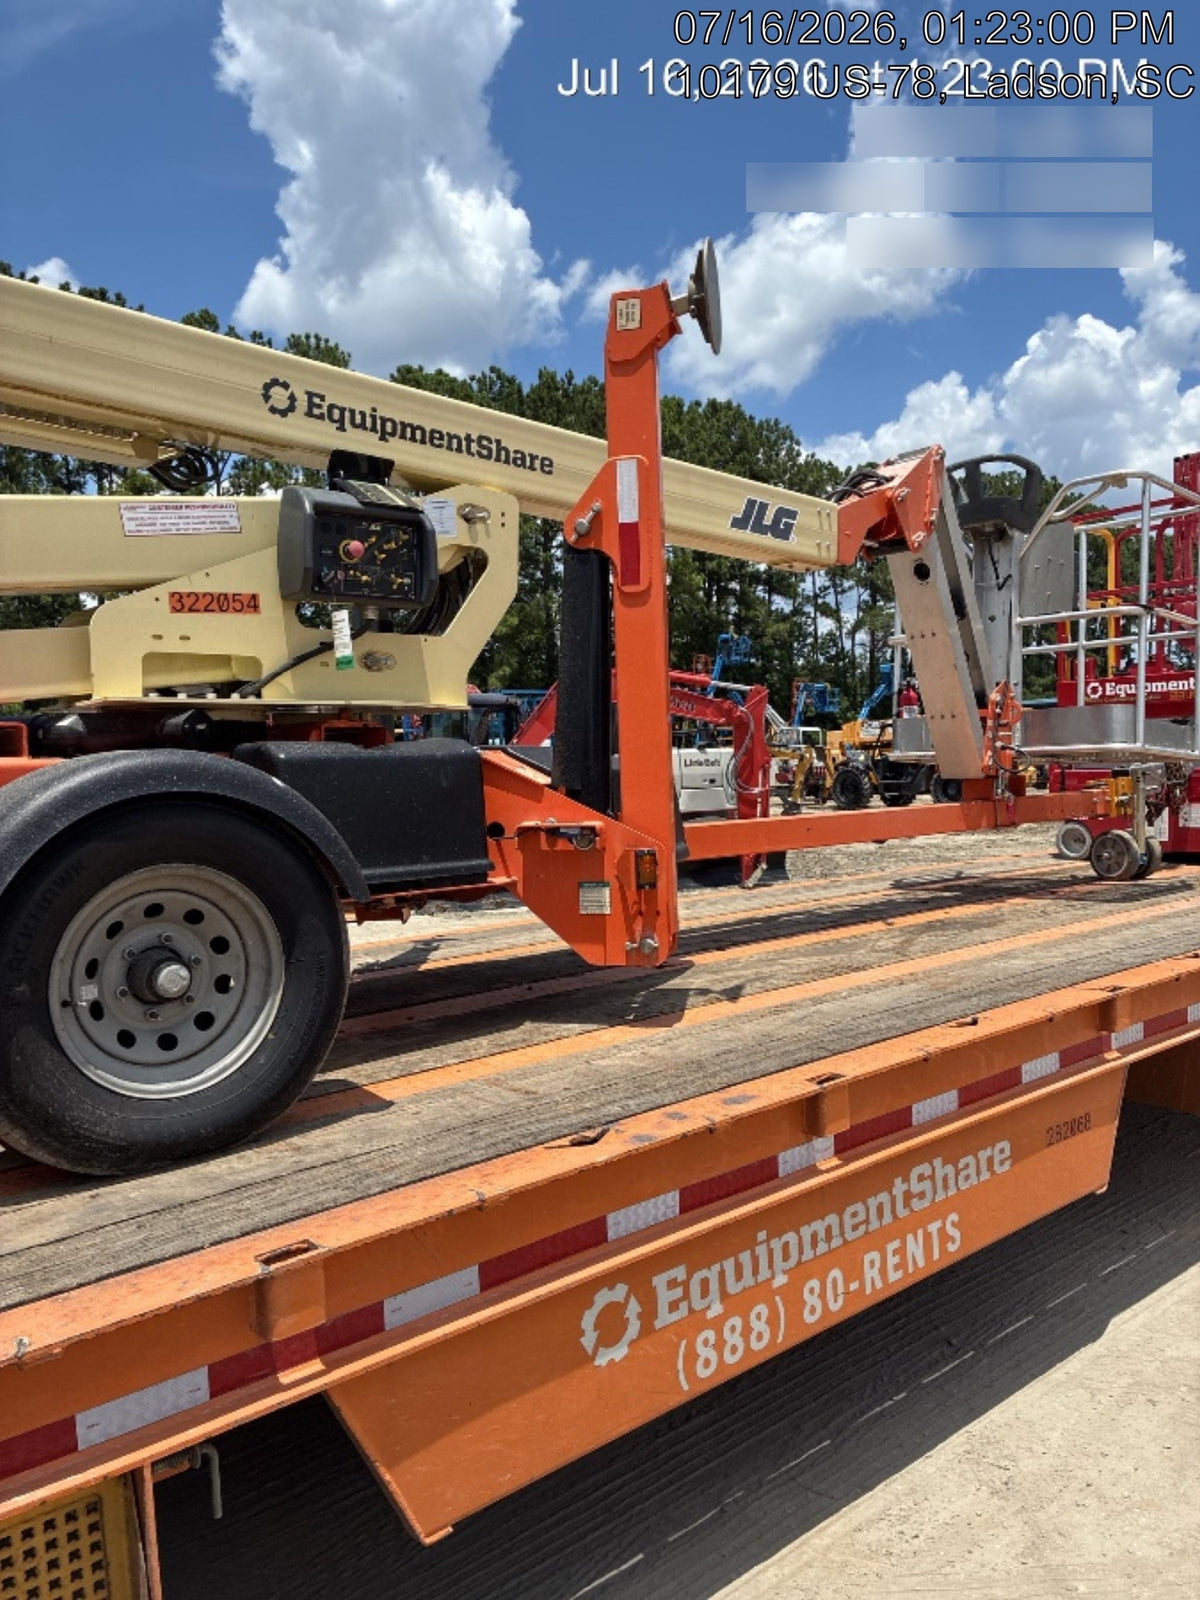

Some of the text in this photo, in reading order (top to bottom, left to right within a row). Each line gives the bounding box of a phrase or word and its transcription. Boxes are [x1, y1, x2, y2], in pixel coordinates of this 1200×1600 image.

[304, 390, 555, 475] EquipmentShare
[728, 496, 800, 543] JLG
[171, 591, 260, 612] 322054
[1105, 676, 1196, 698] Equpment
[652, 1139, 1013, 1329] EquipmentShare
[676, 1212, 962, 1391] (888) 80-RENTS
